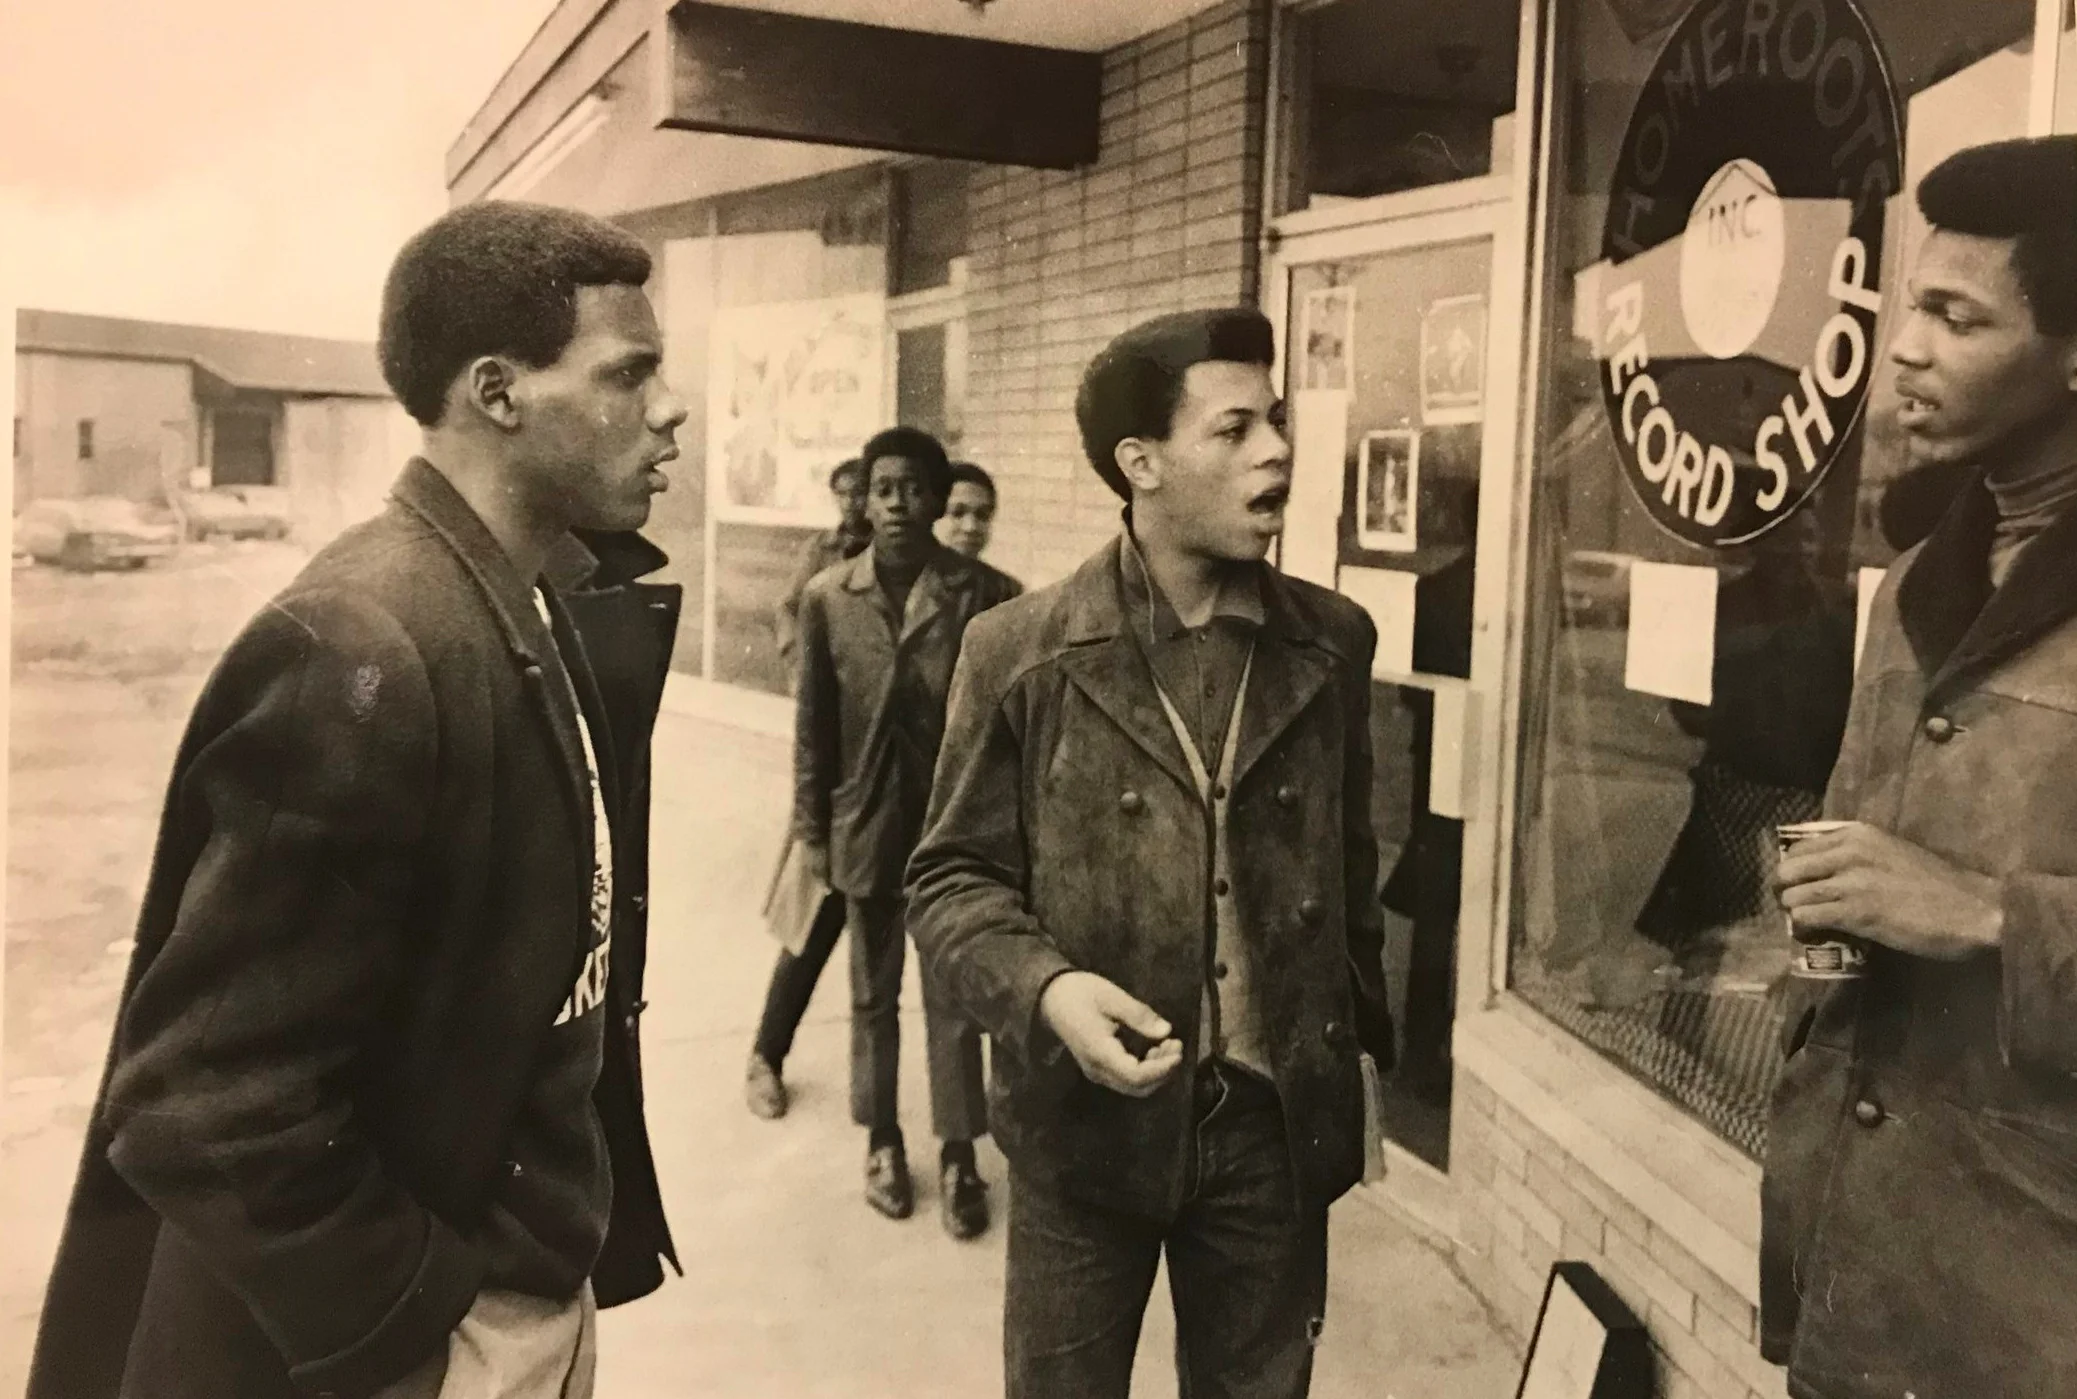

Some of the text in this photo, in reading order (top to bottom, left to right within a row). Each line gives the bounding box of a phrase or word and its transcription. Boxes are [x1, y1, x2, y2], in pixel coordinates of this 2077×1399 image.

[1707, 194, 1761, 247] INC
[1606, 237, 1884, 527] RECORD SHOP
